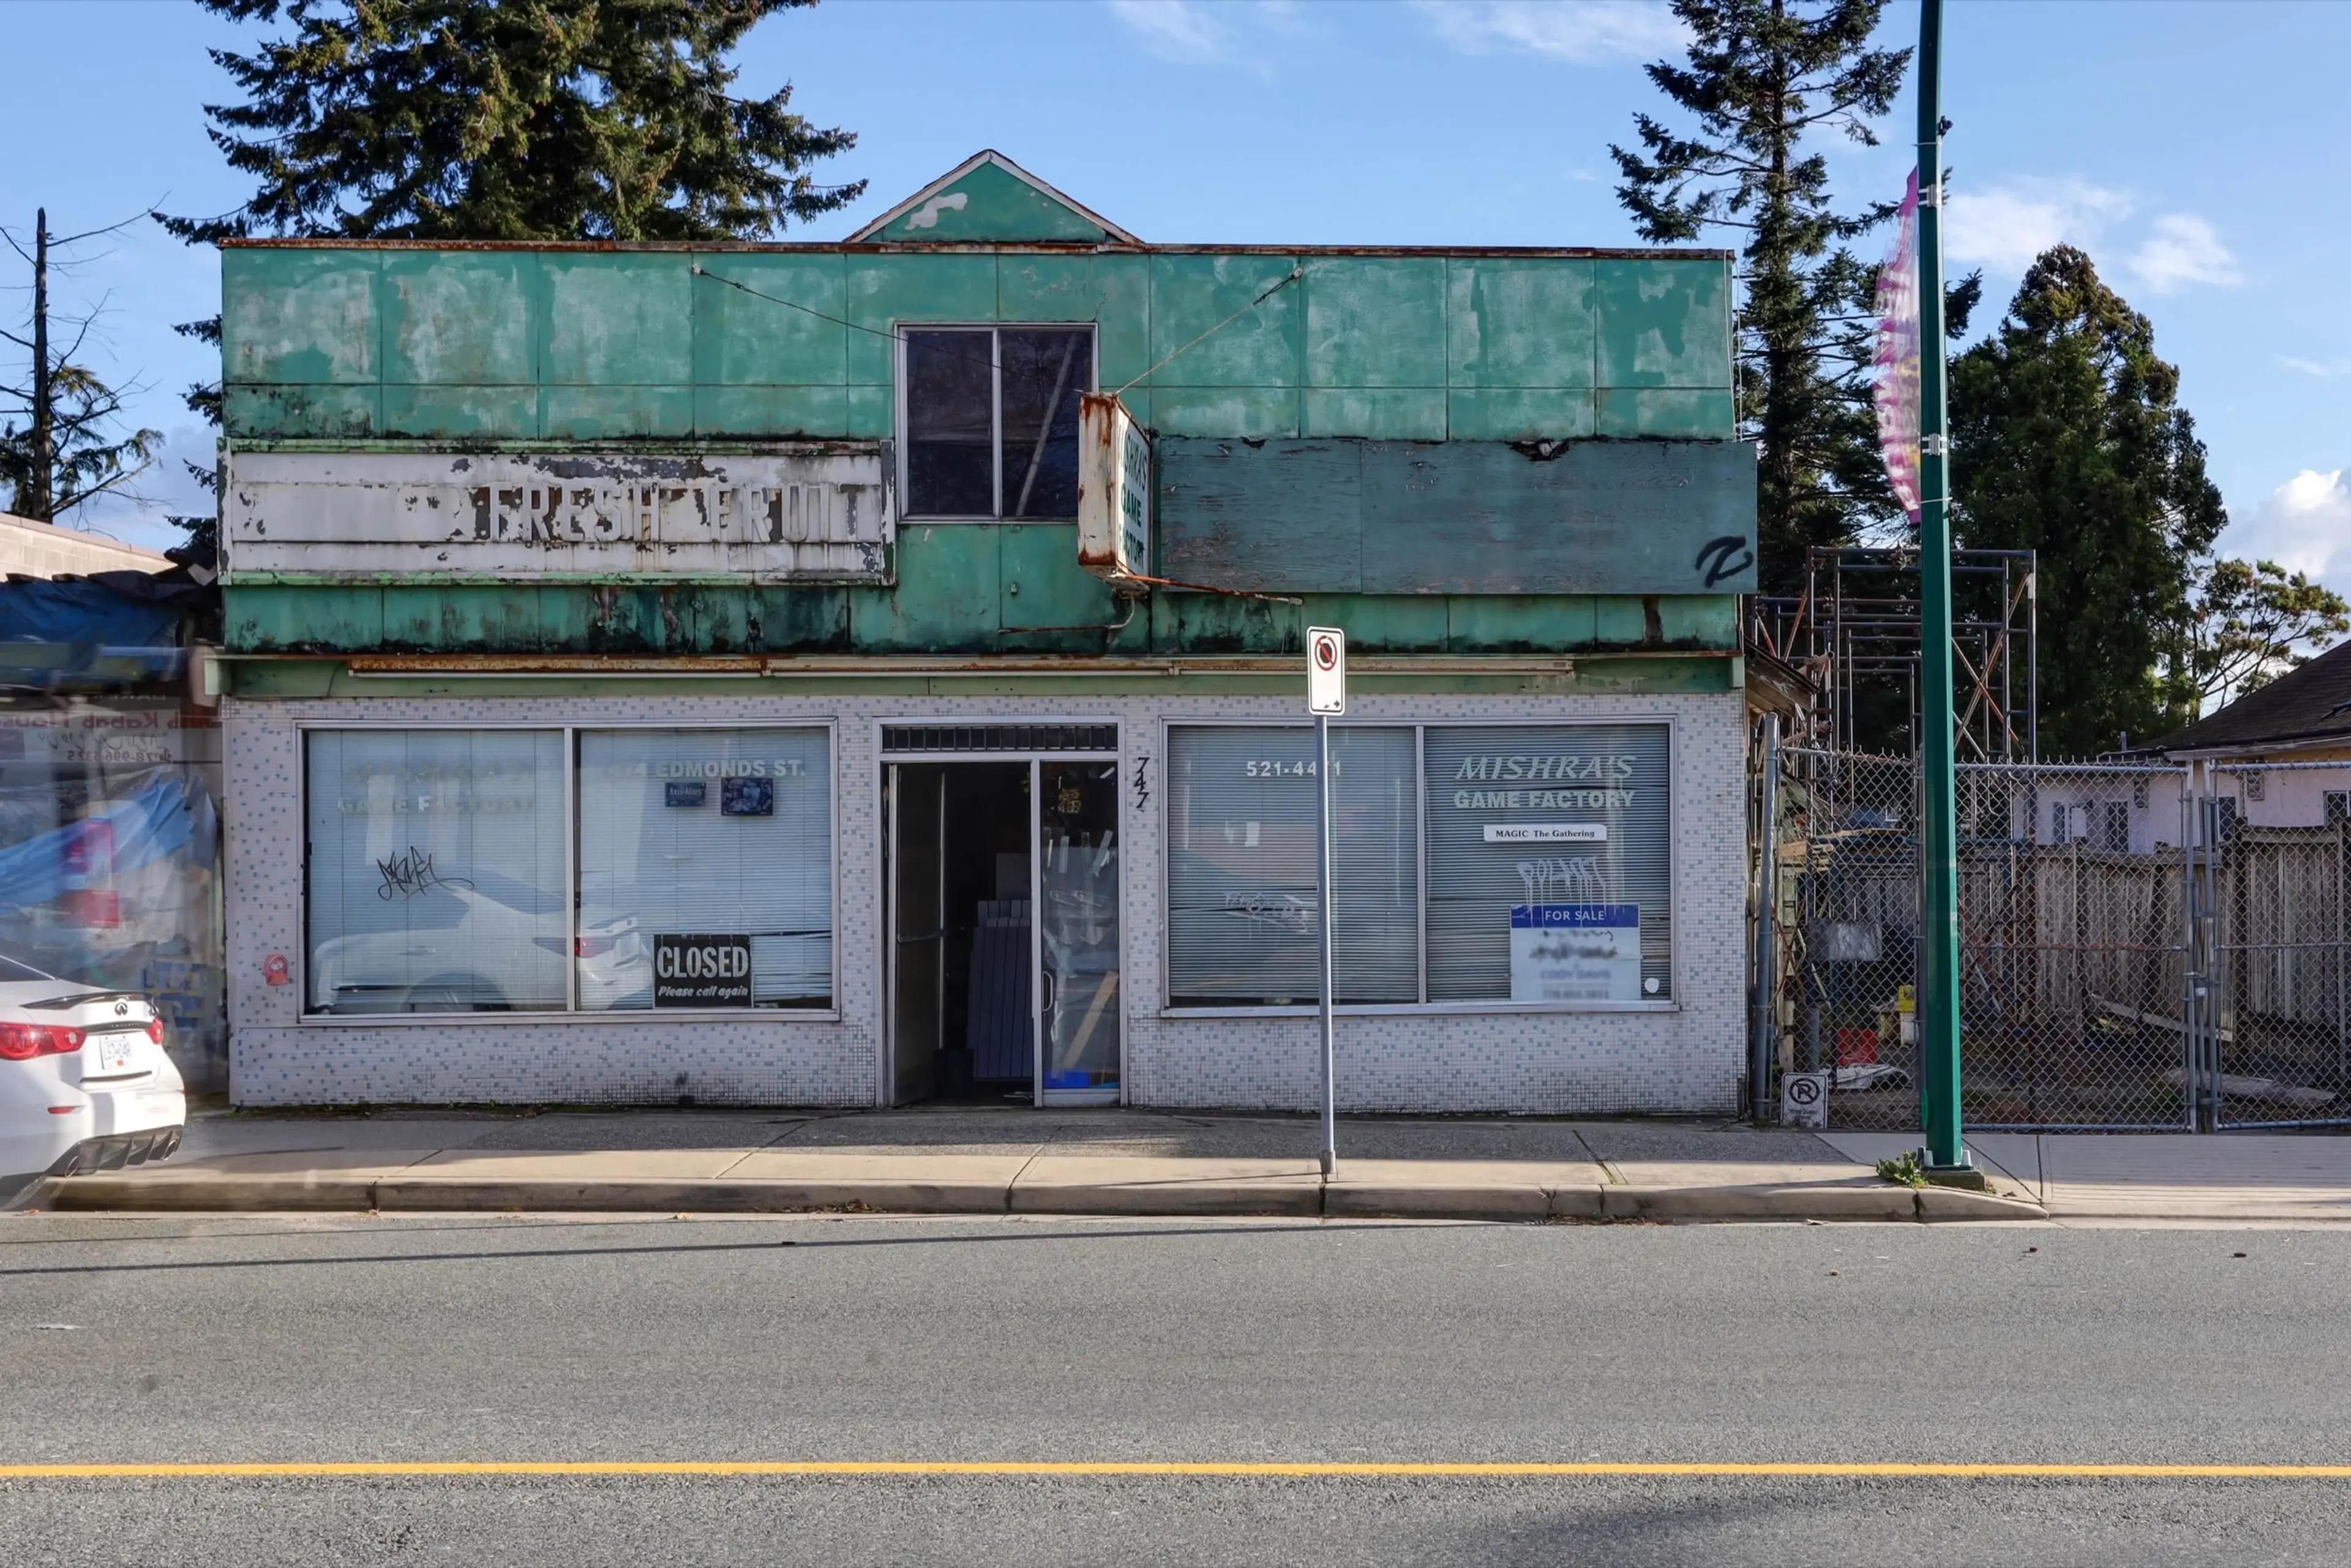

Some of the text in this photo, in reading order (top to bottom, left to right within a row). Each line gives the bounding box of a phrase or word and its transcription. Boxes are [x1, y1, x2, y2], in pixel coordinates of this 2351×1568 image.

[489, 481, 867, 542] FRESH FRUIT
[1121, 483, 1142, 528] GAME
[656, 760, 765, 778] EDMONDS
[774, 759, 806, 777] ST.
[1246, 760, 1341, 776] 521-441
[1455, 756, 1637, 780] MISHRA'S
[1454, 790, 1635, 809] GAME FACTORY
[1496, 829, 1595, 839] MAGIC The Gathering
[1545, 910, 1605, 921] FOR SALE
[656, 946, 749, 978] CLOSED
[658, 985, 749, 1000] Please call again
